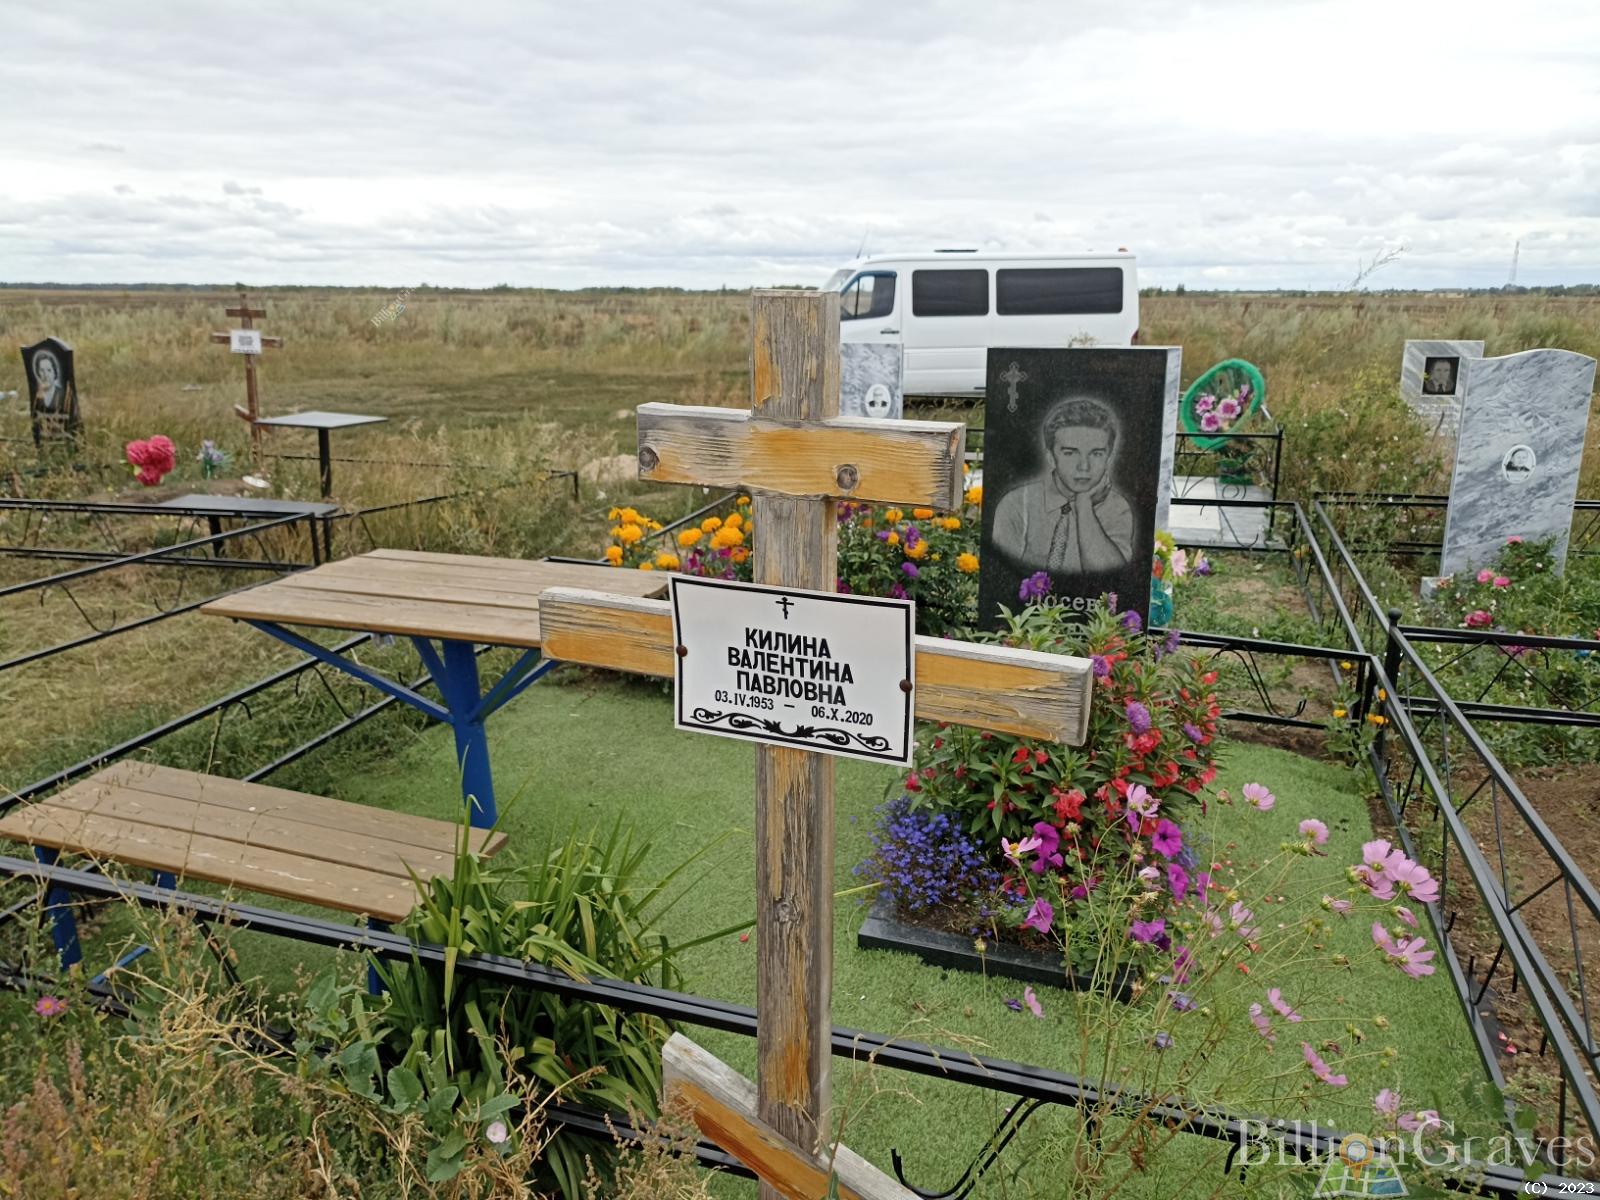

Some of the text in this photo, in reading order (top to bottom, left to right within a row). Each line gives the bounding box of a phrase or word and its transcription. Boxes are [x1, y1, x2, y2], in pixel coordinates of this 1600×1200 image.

[745, 627, 831, 659] КИЛИНА
[728, 647, 854, 685] ВАЛЕНТИНА
[736, 670, 847, 706] ПАВЛОВНА
[714, 690, 775, 711] 03.IV.1953
[811, 706, 873, 726] 06.X.2020
